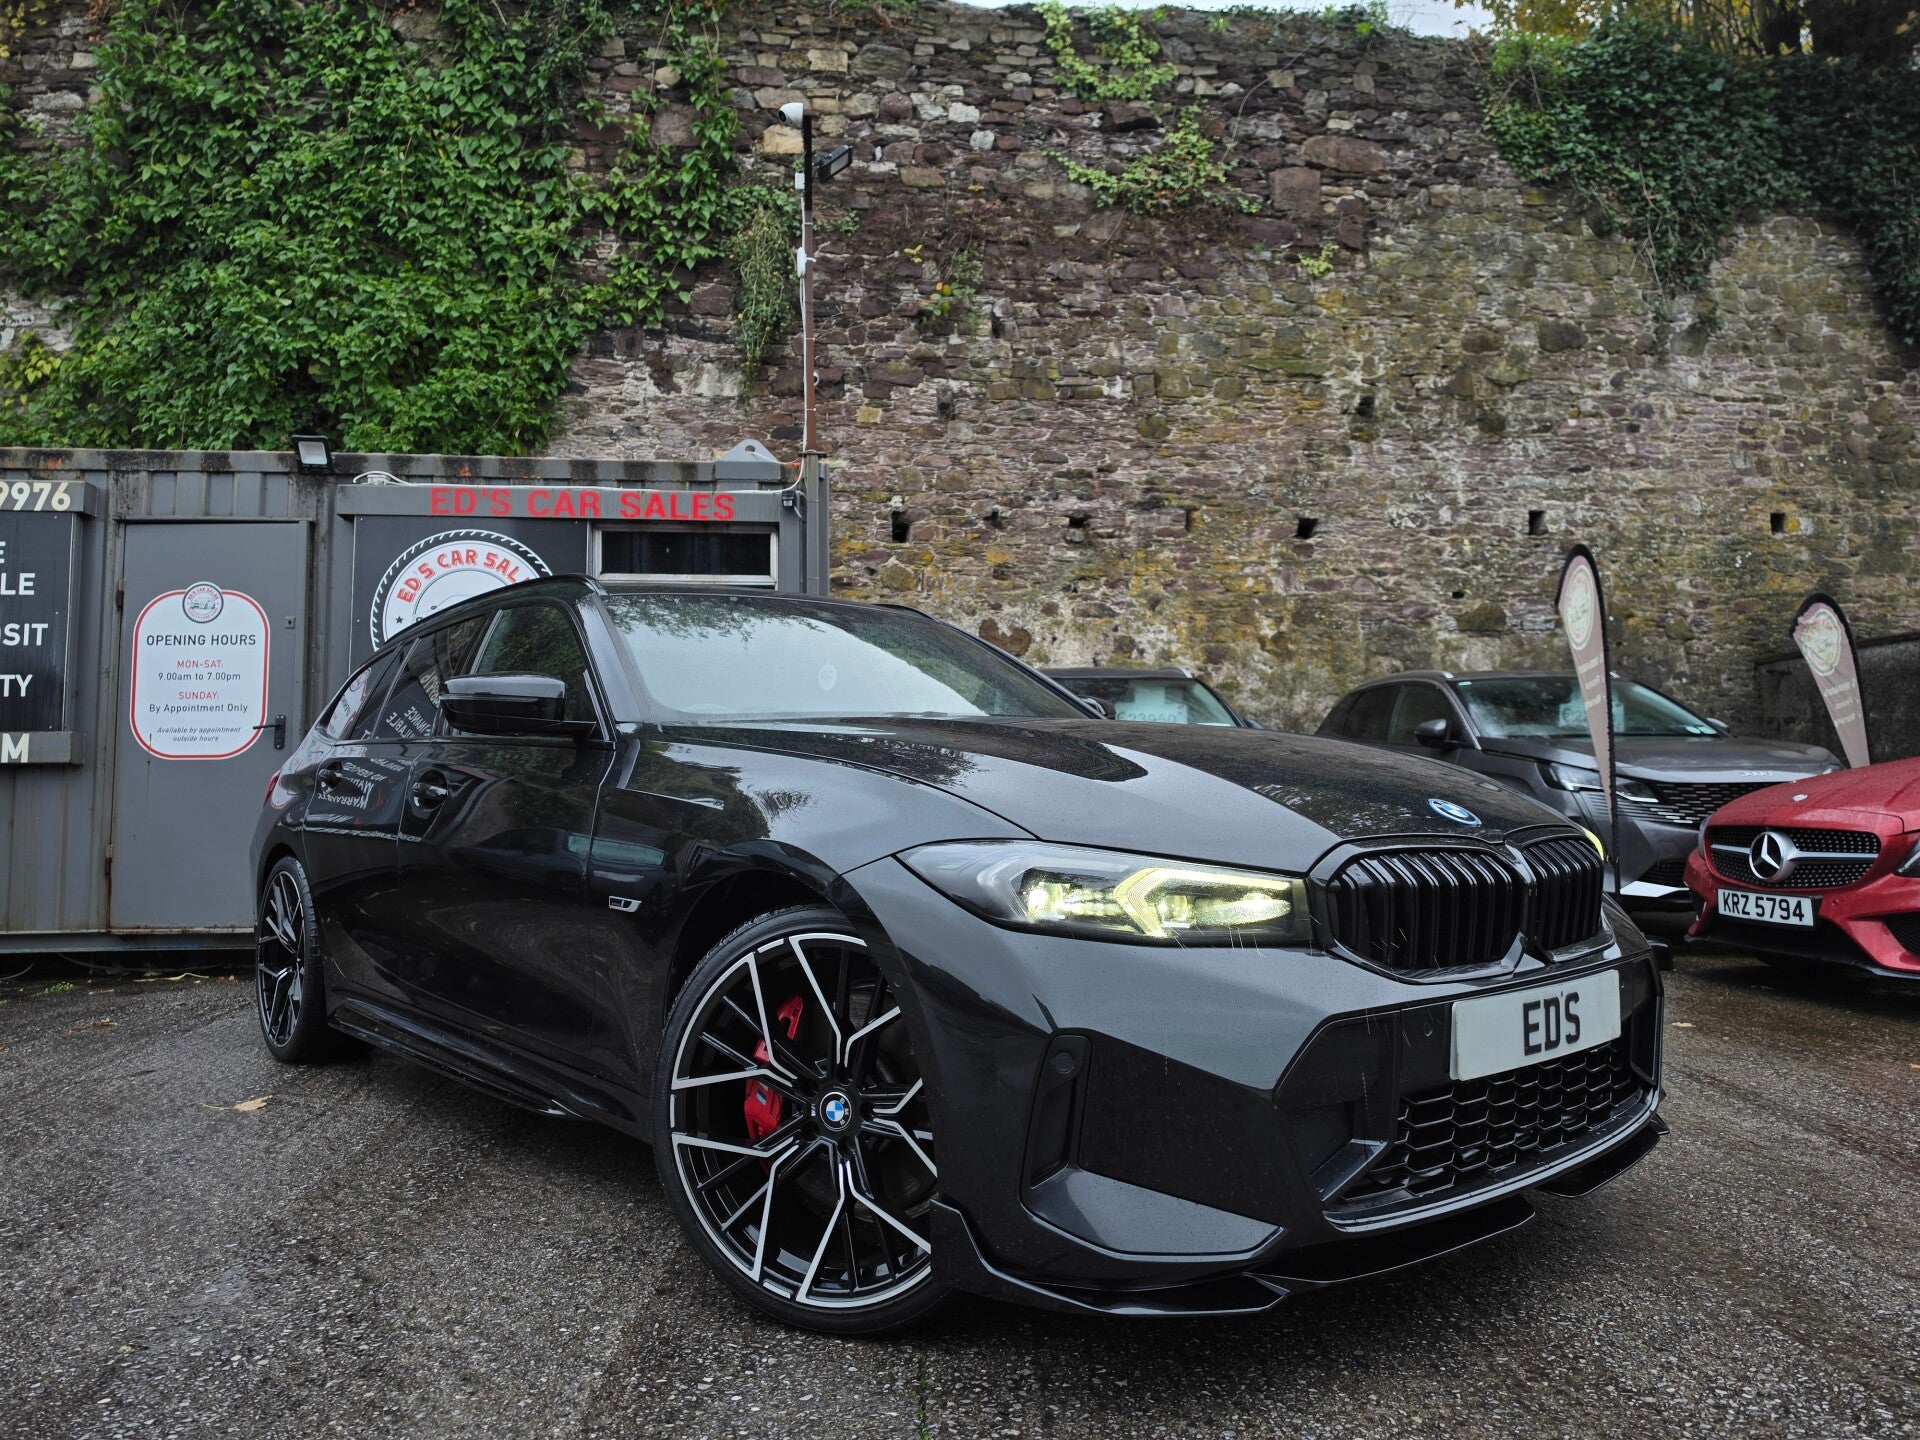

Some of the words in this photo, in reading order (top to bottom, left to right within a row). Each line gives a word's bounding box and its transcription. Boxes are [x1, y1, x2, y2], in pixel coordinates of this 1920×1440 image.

[430, 487, 512, 517] ED'S
[527, 489, 600, 518] CAR
[619, 491, 735, 521] SALES
[437, 548, 478, 568] CAR
[483, 551, 530, 584] SAL
[0, 572, 36, 595] LE
[0, 622, 49, 646] SIT
[146, 634, 206, 646] OPENING
[211, 634, 256, 646] HOURS
[0, 674, 33, 697] TY
[158, 672, 192, 681] 9.00am
[195, 672, 204, 681] to
[207, 671, 241, 682] 7.00pm
[149, 703, 161, 714] By
[163, 703, 224, 714] Appointment
[227, 703, 248, 713] Only
[1, 733, 30, 763] M
[1723, 891, 1751, 916] KRZ
[1755, 896, 1804, 923] 5794
[1523, 990, 1581, 1056] ED'S
